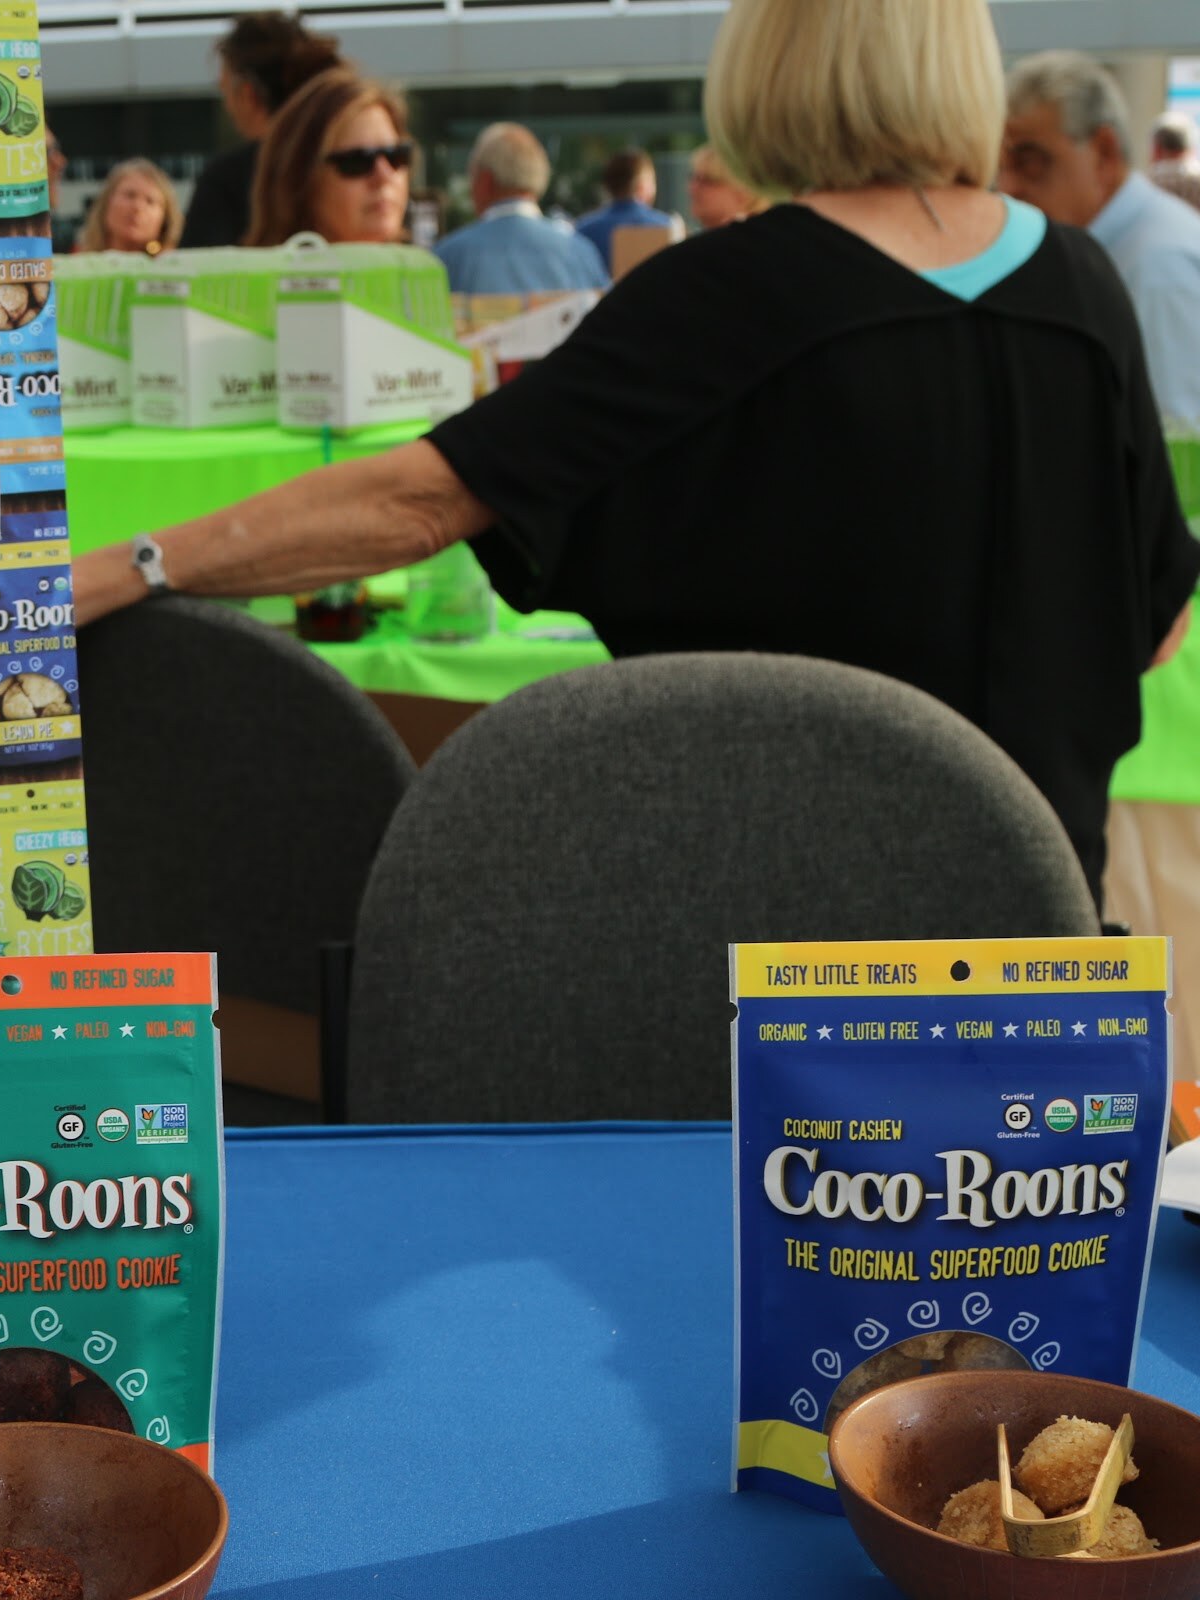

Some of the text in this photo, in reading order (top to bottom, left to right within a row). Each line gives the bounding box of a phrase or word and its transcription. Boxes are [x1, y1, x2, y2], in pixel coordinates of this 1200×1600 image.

[9, 262, 47, 278] SALTED
[14, 636, 61, 653] SUPERFOOD
[3, 721, 55, 743] LEMON PIE
[16, 831, 54, 850] CHEEZY
[50, 968, 174, 990] NO REFINED SUGAR
[766, 963, 917, 986] TASTY LITTLE TREATS
[1002, 960, 1129, 982] NO REFINED SUGAR
[6, 1025, 43, 1042] VEGAN
[76, 1022, 109, 1039] PALEO
[146, 1020, 196, 1038] NON-GMO
[759, 1018, 1148, 1042] ORGANIC GLUTEN FREE VEGAN PALEO NON-GMO
[1112, 1104, 1134, 1112] GMO
[1113, 1097, 1135, 1105] NON
[1009, 1111, 1027, 1122] GF
[1051, 1106, 1071, 1114] USDA
[62, 1122, 79, 1132] GF
[103, 1116, 122, 1124] USDA
[1087, 1119, 1132, 1127] VERIFIED
[139, 1129, 185, 1137] VERIFIED
[783, 1117, 902, 1141] COCONUT CASHEW
[997, 1131, 1040, 1139] Gluten-Free
[784, 1234, 1110, 1282] THE ORIGINAL SUPERFOOD COOKIE
[116, 1254, 182, 1288] COOKIE
